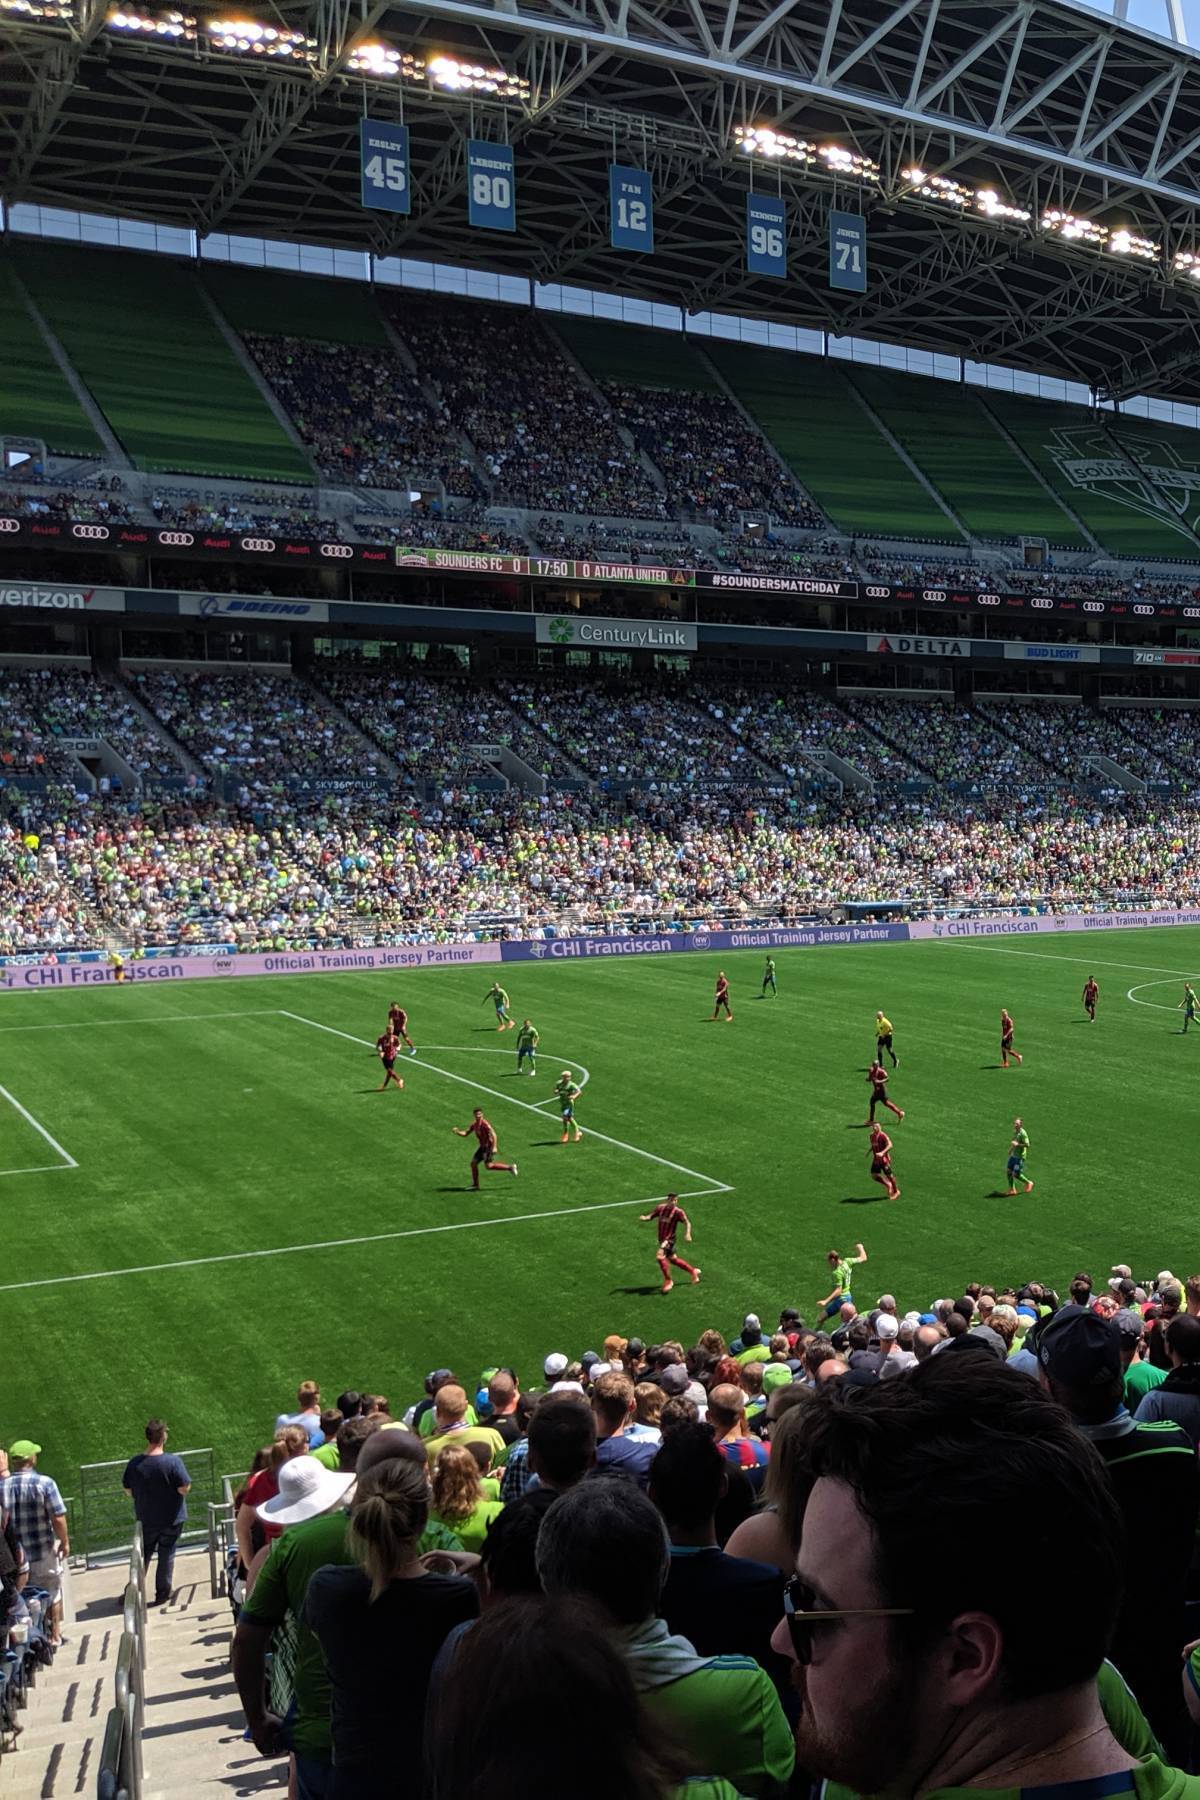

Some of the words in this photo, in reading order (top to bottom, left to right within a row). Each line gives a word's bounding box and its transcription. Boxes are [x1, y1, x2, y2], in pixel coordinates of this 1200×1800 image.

[365, 155, 405, 191] 45
[472, 173, 511, 209] 80
[622, 183, 641, 195] FAN
[618, 199, 647, 232] 12
[751, 226, 783, 258] 96
[836, 242, 861, 273] 71
[32, 526, 60, 535] Audi
[120, 532, 148, 542] Audi
[204, 538, 230, 548] Audi
[285, 545, 310, 554] Audi
[362, 551, 387, 560] Audi
[435, 553, 488, 570] SOUNDERS
[490, 557, 502, 570] FC
[513, 559, 521, 572] 0
[537, 560, 568, 576] 17:50
[583, 563, 590, 577] 0
[595, 564, 633, 580] ATLANTA
[636, 568, 667, 583] UNITED
[712, 574, 840, 595] #SOUNDERSMATCHDAY
[226, 602, 311, 615] BOEING
[580, 624, 686, 646] CenturyLink
[900, 639, 962, 655] DELTA
[1027, 647, 1049, 657] BUD
[1050, 648, 1080, 659] LIGHT
[1135, 652, 1154, 662] 710
[947, 923, 969, 935] CHI
[974, 920, 1038, 934] Franciscan
[1084, 917, 1113, 927] Official
[1116, 915, 1148, 926] Training
[1150, 914, 1175, 924] Jersey
[731, 933, 770, 947] Official
[772, 931, 815, 945] Training
[818, 930, 850, 943] Jersey
[853, 929, 890, 940] Partner
[551, 942, 581, 957] CHI
[585, 938, 671, 955] Franciscan
[216, 960, 232, 969] NW
[264, 955, 315, 971] Official
[319, 952, 374, 968] Training
[380, 949, 422, 966] Jersey
[427, 948, 474, 961] Partner
[24, 969, 62, 986] CHI
